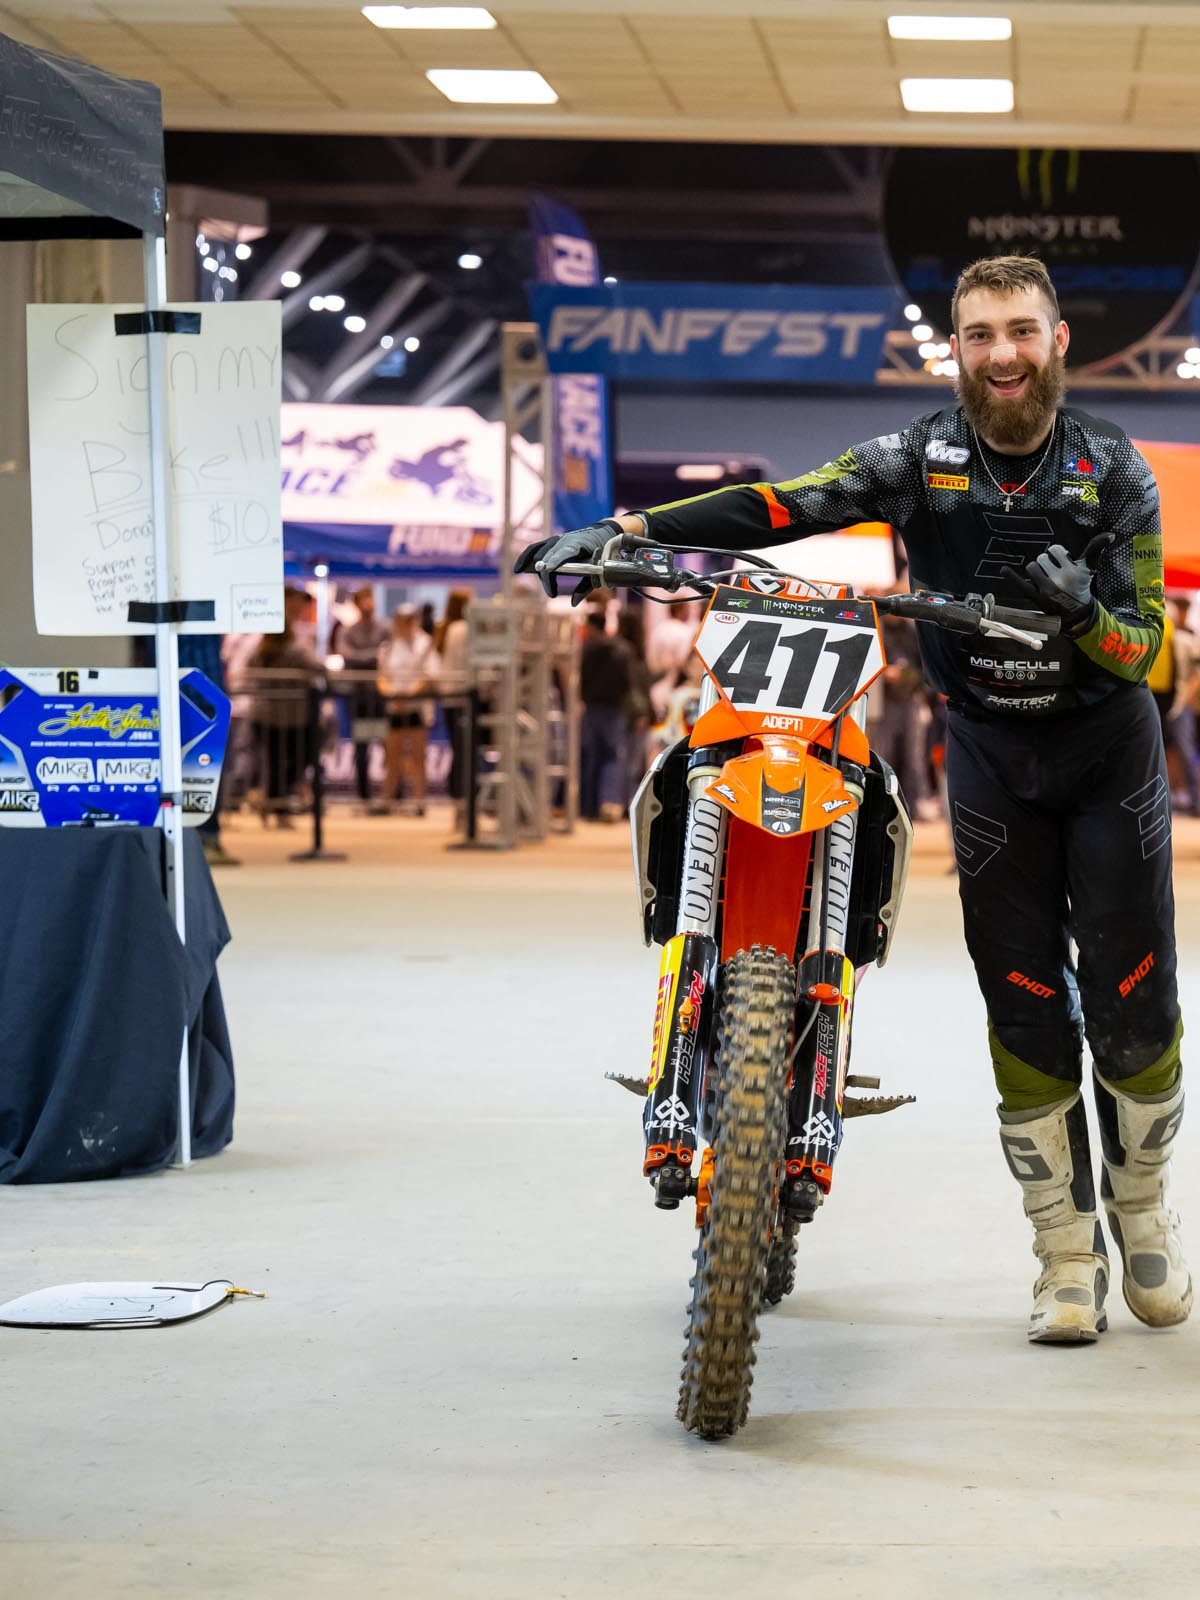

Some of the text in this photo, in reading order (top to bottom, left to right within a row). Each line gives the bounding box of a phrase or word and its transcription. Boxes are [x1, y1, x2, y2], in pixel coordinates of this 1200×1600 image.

[547, 305, 886, 358] FANFEST
[927, 444, 971, 464] WC
[928, 475, 967, 488] PIRELLI
[1061, 483, 1100, 503] SMX
[772, 601, 825, 614] MONSTER
[711, 620, 875, 713] 411
[970, 656, 1060, 670] MOLECULE
[56, 671, 80, 693] 16
[987, 693, 1057, 705] RACETECH
[761, 715, 800, 730] ADEPT
[47, 784, 158, 793] RACING
[1006, 970, 1057, 999] SHOT
[1118, 952, 1155, 999] SHOT
[813, 1010, 831, 1100] RACETECH
